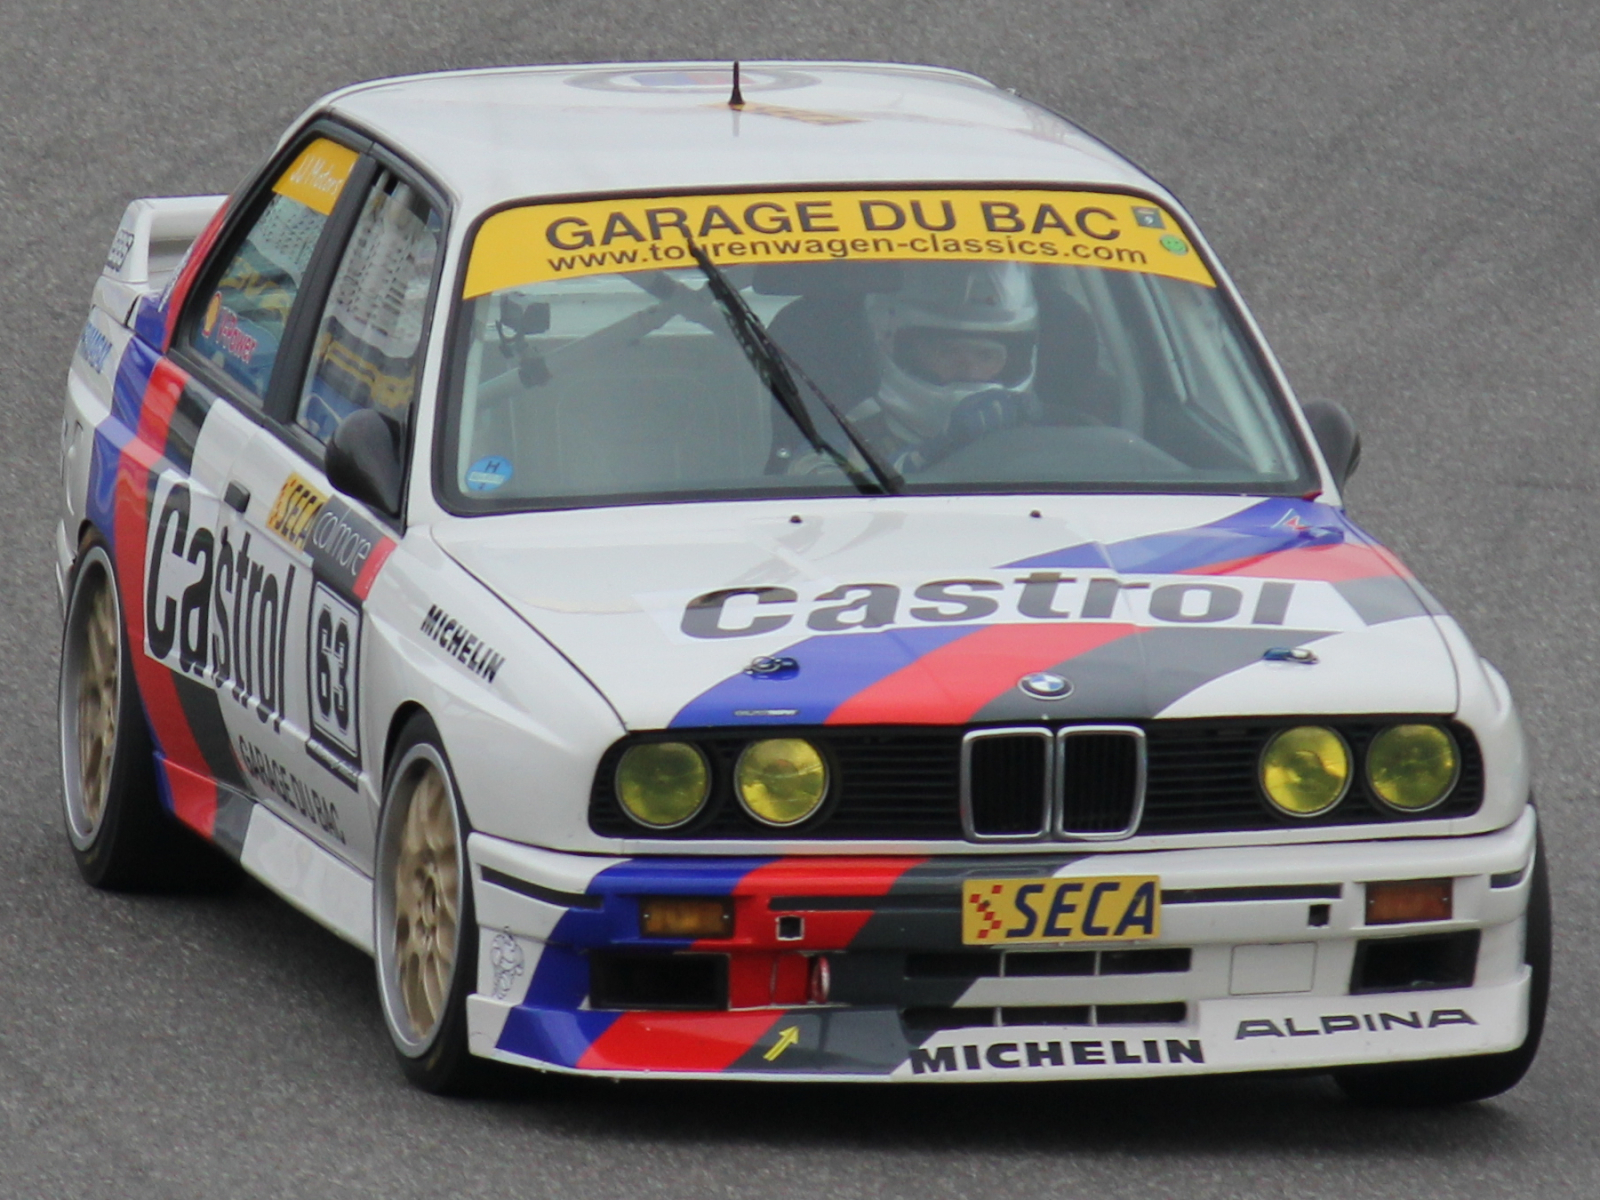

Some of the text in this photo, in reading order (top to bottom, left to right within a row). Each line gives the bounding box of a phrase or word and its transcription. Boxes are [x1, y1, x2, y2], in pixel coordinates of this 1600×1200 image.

[546, 199, 1121, 250] GARAGE DU BAC
[148, 482, 296, 735] Castrol
[317, 605, 350, 735] 63
[420, 603, 506, 684] MICHELIN
[1005, 881, 1155, 938] SECA
[1235, 1008, 1477, 1040] ALPINA
[911, 1039, 1205, 1075] MICHELIN
